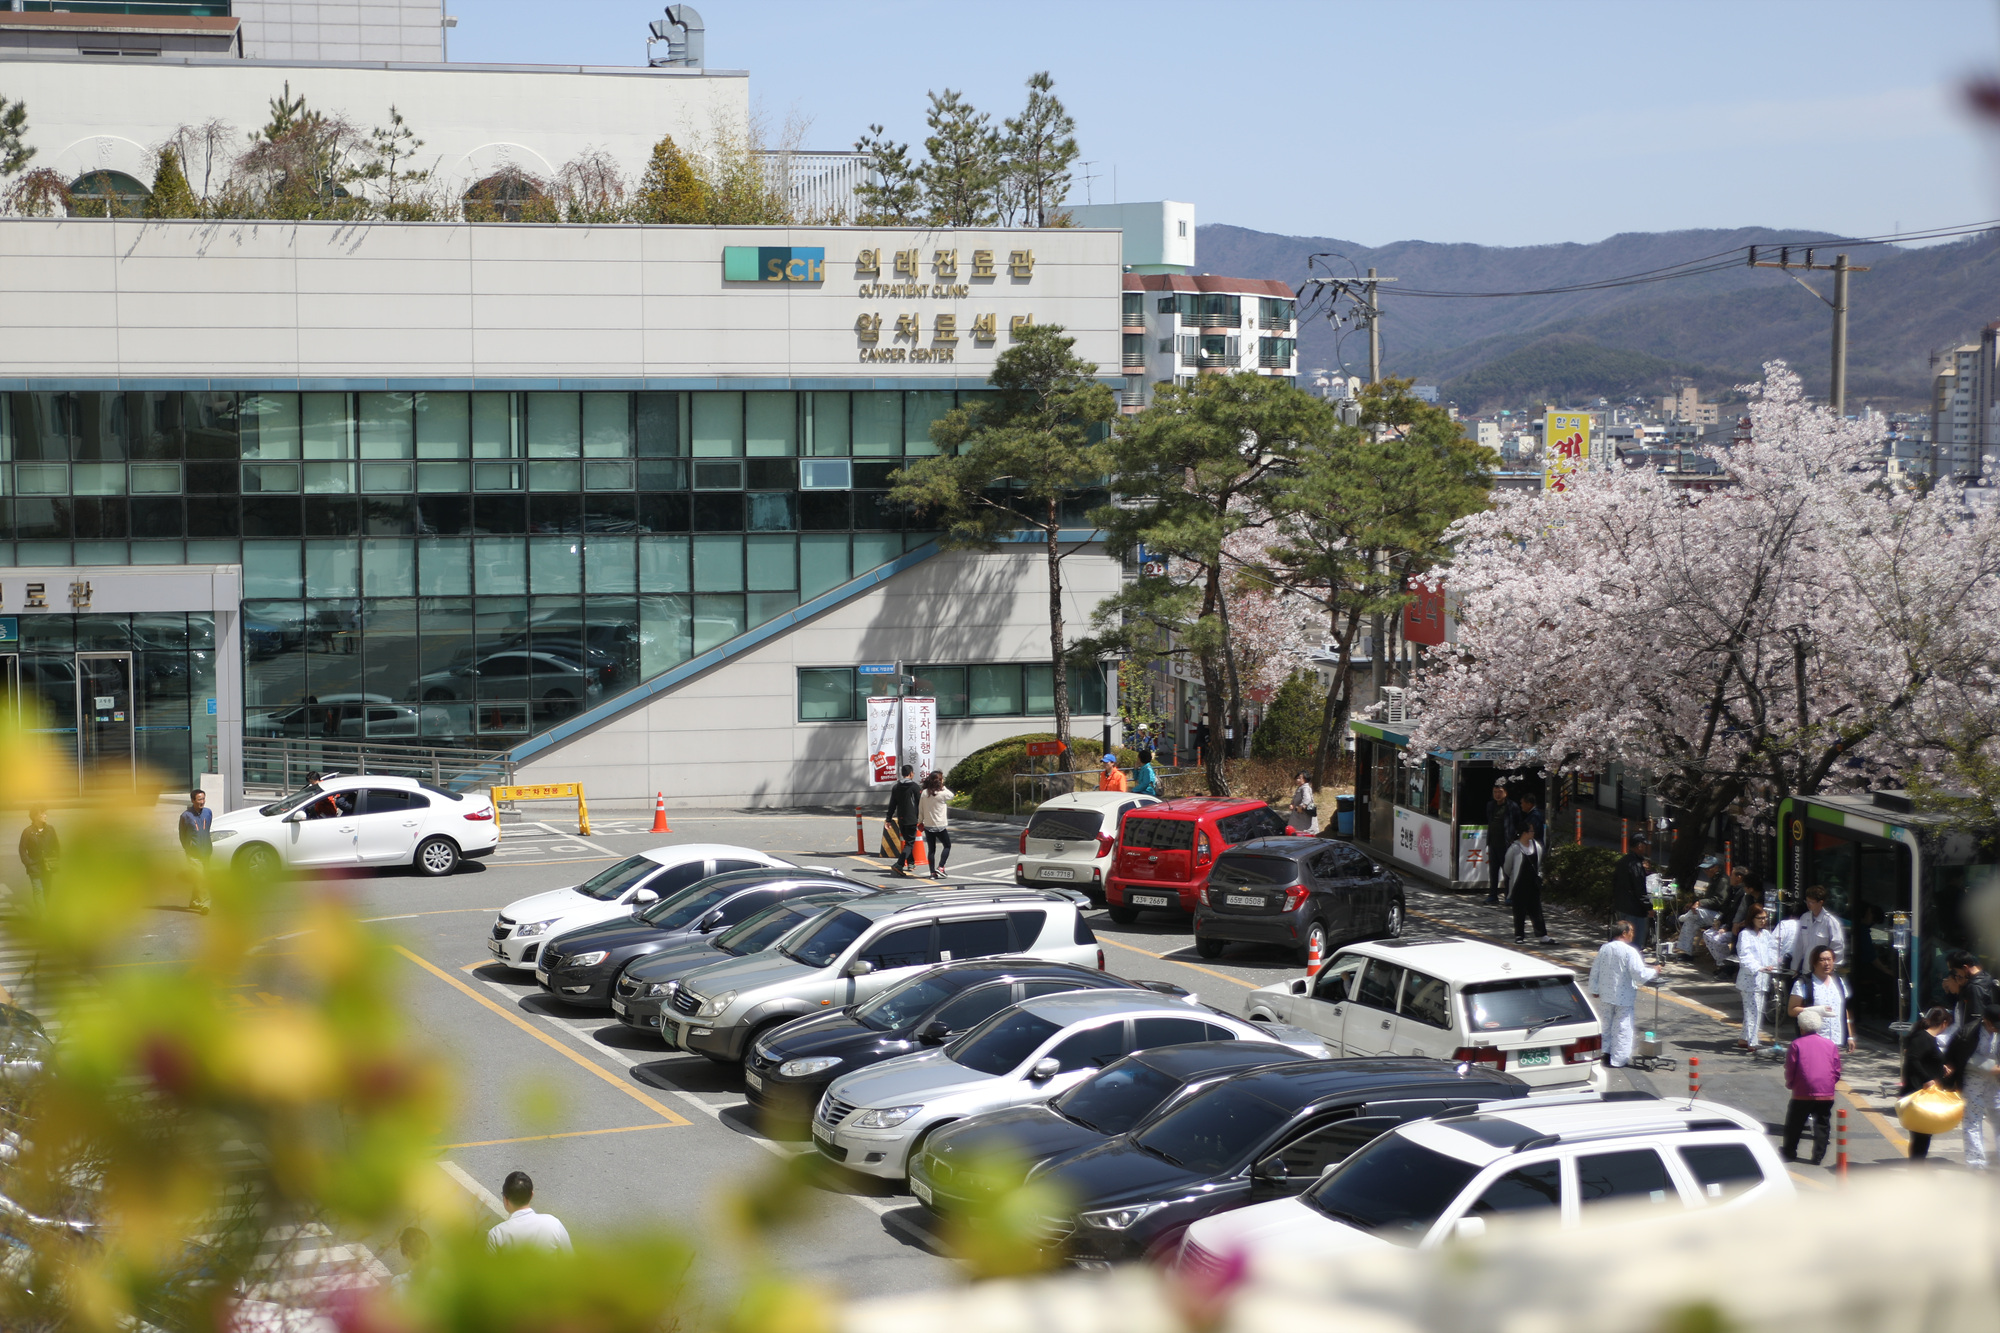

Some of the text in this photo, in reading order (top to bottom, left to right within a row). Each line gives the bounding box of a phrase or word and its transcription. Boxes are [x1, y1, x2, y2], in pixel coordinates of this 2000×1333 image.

[767, 258, 825, 282] SCH
[857, 248, 1035, 278] 외래진료관
[860, 283, 969, 298] OUTPATIENT CLINIC
[858, 312, 1034, 342] 암치료센터
[860, 347, 954, 361] CANCER CENTER
[1556, 417, 1580, 429] 한식
[0, 581, 94, 609] 료관
[919, 705, 931, 754] 주차대행
[1149, 897, 1165, 905] 2669
[1520, 1051, 1550, 1065] 6353
